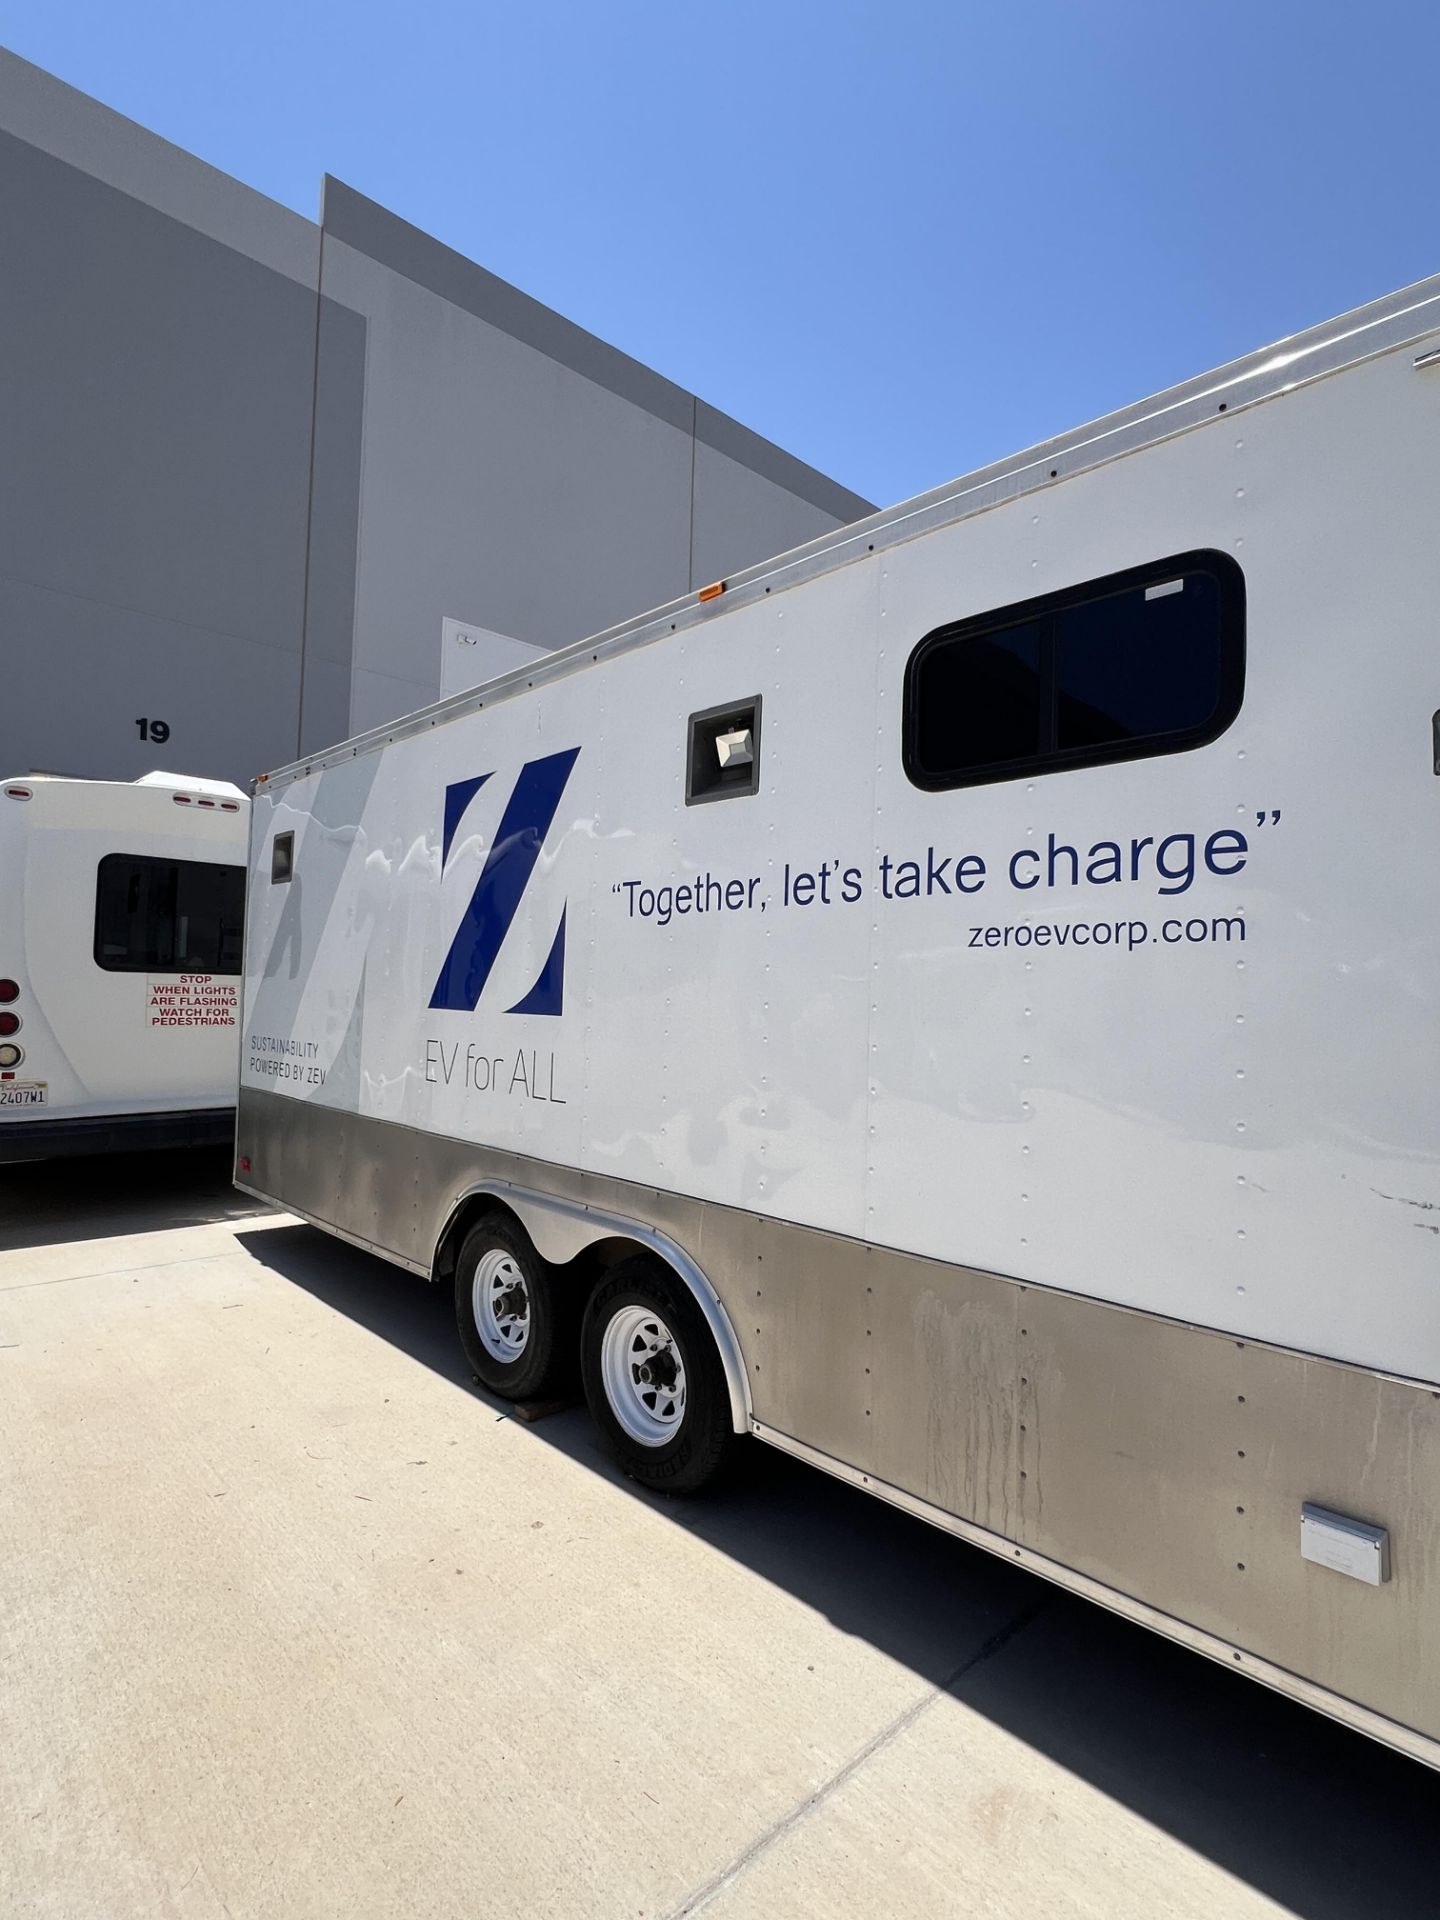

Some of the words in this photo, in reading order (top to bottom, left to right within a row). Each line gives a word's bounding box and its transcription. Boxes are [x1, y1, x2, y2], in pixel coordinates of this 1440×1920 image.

[135, 718, 170, 744] 19
[611, 872, 767, 926] “Together,
[783, 860, 863, 907] let’s
[879, 847, 987, 900] take
[1008, 809, 1282, 896] charge”
[967, 914, 1247, 952] zeroevcorp.com
[180, 975, 212, 984] STOP
[153, 986, 190, 994] WHEN
[194, 987, 236, 995] LIGHTS
[150, 997, 176, 1006] ARE
[180, 997, 238, 1006] FLASHING
[152, 1017, 236, 1026] PEDESTRIANS
[159, 1008, 202, 1017] WATCH
[206, 1008, 229, 1017] FOR
[251, 1035, 319, 1059] SUSTAINABILITY
[250, 1057, 290, 1079] POWERED
[293, 1064, 304, 1081] BY
[307, 1067, 327, 1085] ZEV
[425, 1039, 459, 1085] EV
[465, 1043, 505, 1092] for
[508, 1048, 567, 1105] ALL
[0, 1090, 45, 1105] 2407W1
